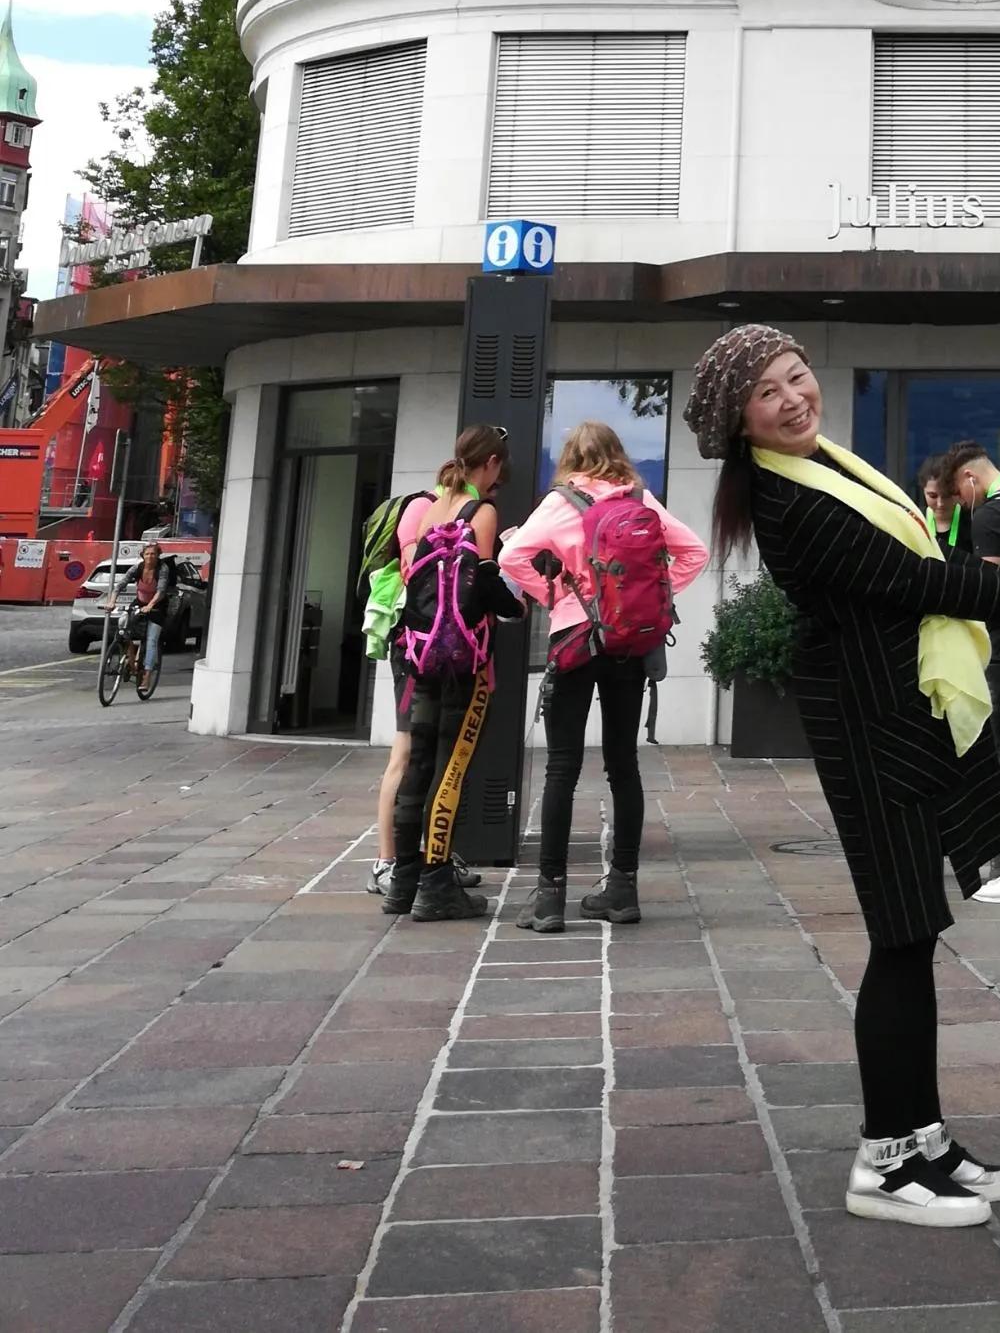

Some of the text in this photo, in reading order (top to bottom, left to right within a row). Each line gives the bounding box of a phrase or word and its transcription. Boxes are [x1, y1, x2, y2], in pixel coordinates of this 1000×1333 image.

[144, 214, 213, 248] Geneva
[828, 180, 985, 240] Julius
[463, 678, 489, 744] READY
[447, 759, 460, 788] START
